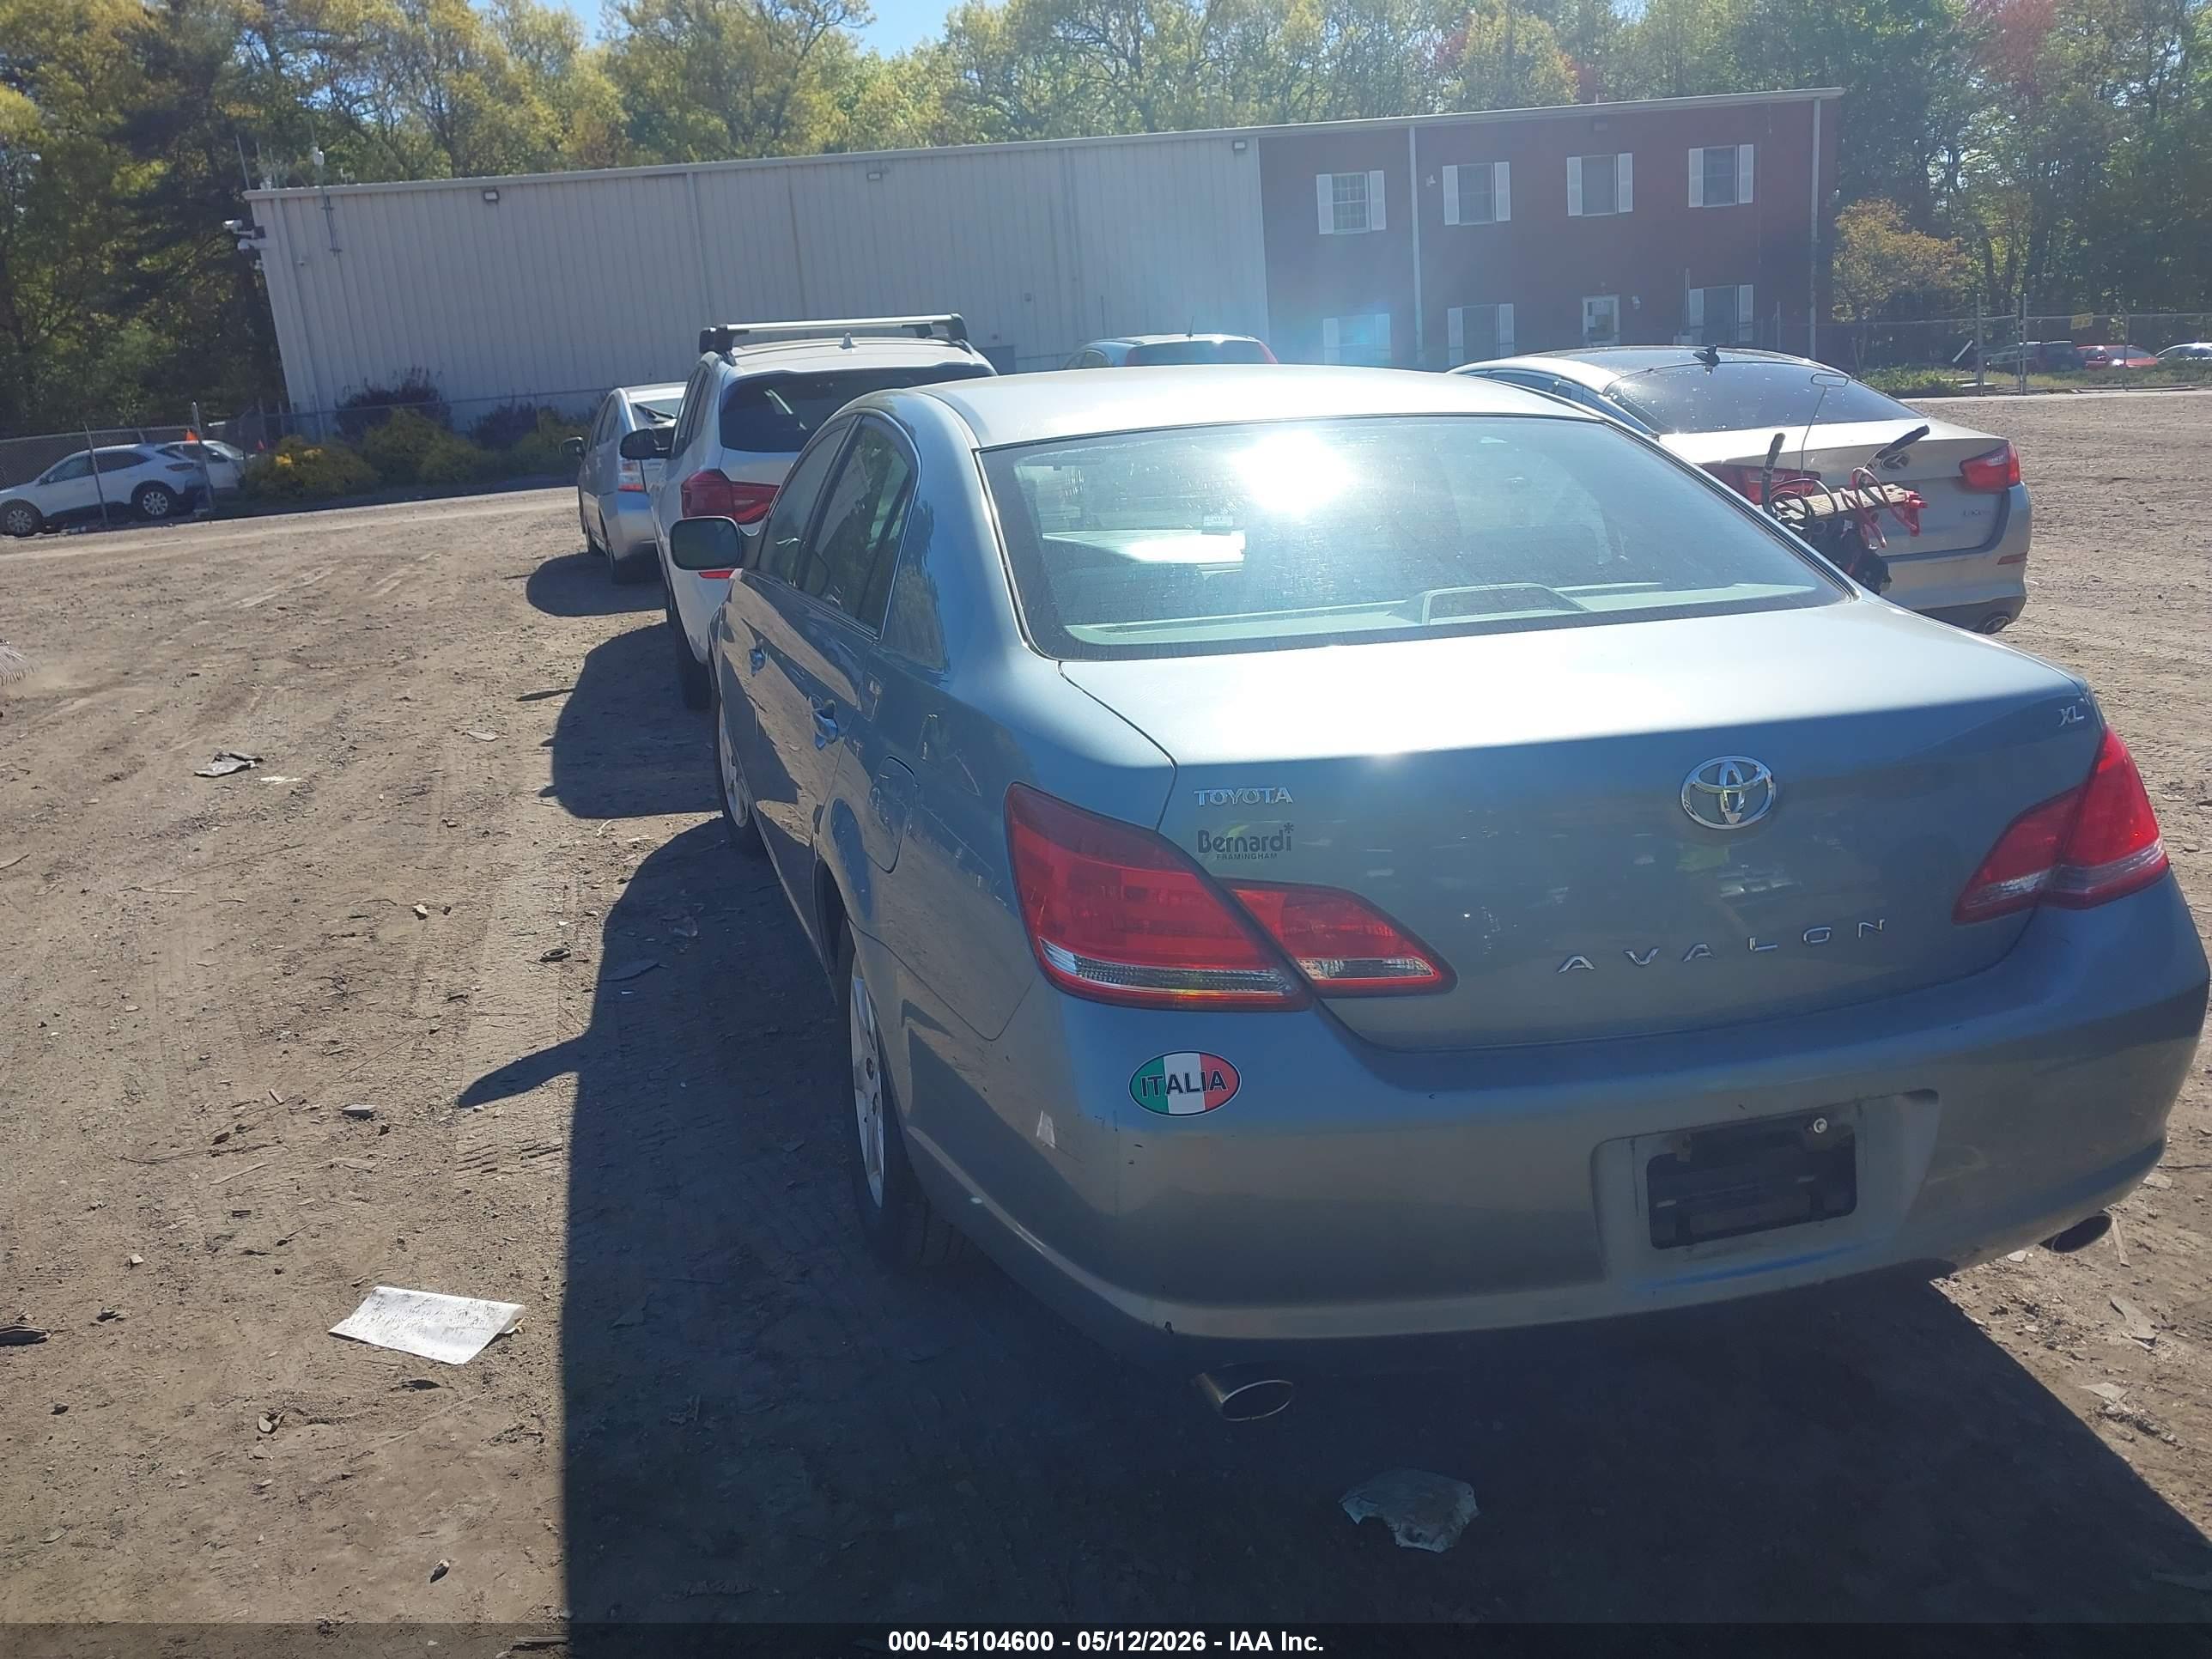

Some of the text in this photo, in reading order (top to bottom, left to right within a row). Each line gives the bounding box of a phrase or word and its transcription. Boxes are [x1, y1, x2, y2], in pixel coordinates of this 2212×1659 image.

[2057, 705, 2085, 727] XL
[1194, 787, 1293, 806] TOYOTA
[1197, 822, 1295, 854] Bernardi
[1557, 918, 1887, 975] AVALON
[1139, 1069, 1229, 1097] ITALIA
